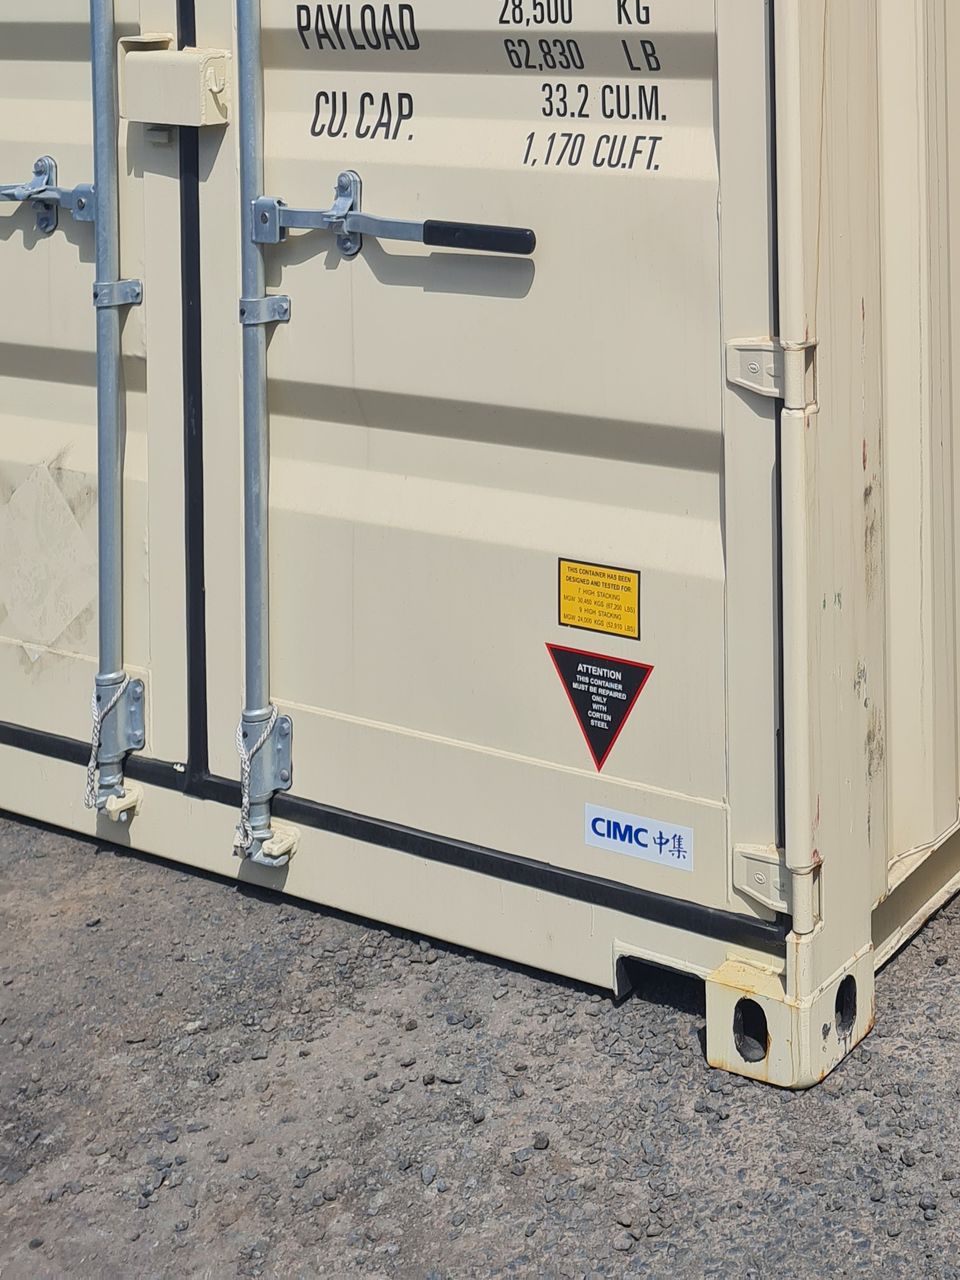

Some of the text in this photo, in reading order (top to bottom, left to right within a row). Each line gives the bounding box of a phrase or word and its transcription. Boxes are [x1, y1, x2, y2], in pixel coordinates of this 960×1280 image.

[296, 3, 420, 50] PAYLOAD
[503, 38, 661, 71] 62,830 LB
[541, 83, 589, 119] 33.2
[601, 84, 667, 121] CU.M.
[522, 132, 662, 170] 1,170 CU.FT.
[565, 575, 590, 585] DESIGNED
[602, 581, 620, 590] TESTED
[567, 566, 578, 574] THIS
[579, 568, 606, 579] CONTAINER
[618, 575, 632, 583] BEEN
[577, 663, 622, 681] ATTENTION
[572, 682, 627, 700] MUST BE REPAIRED
[576, 674, 623, 691] THIS CONTAINER
[591, 694, 607, 704] ONLY
[592, 703, 607, 712] WITH
[587, 710, 612, 722] CORTEN
[590, 719, 609, 730] STEEL
[591, 817, 688, 859] CIMC 中集
